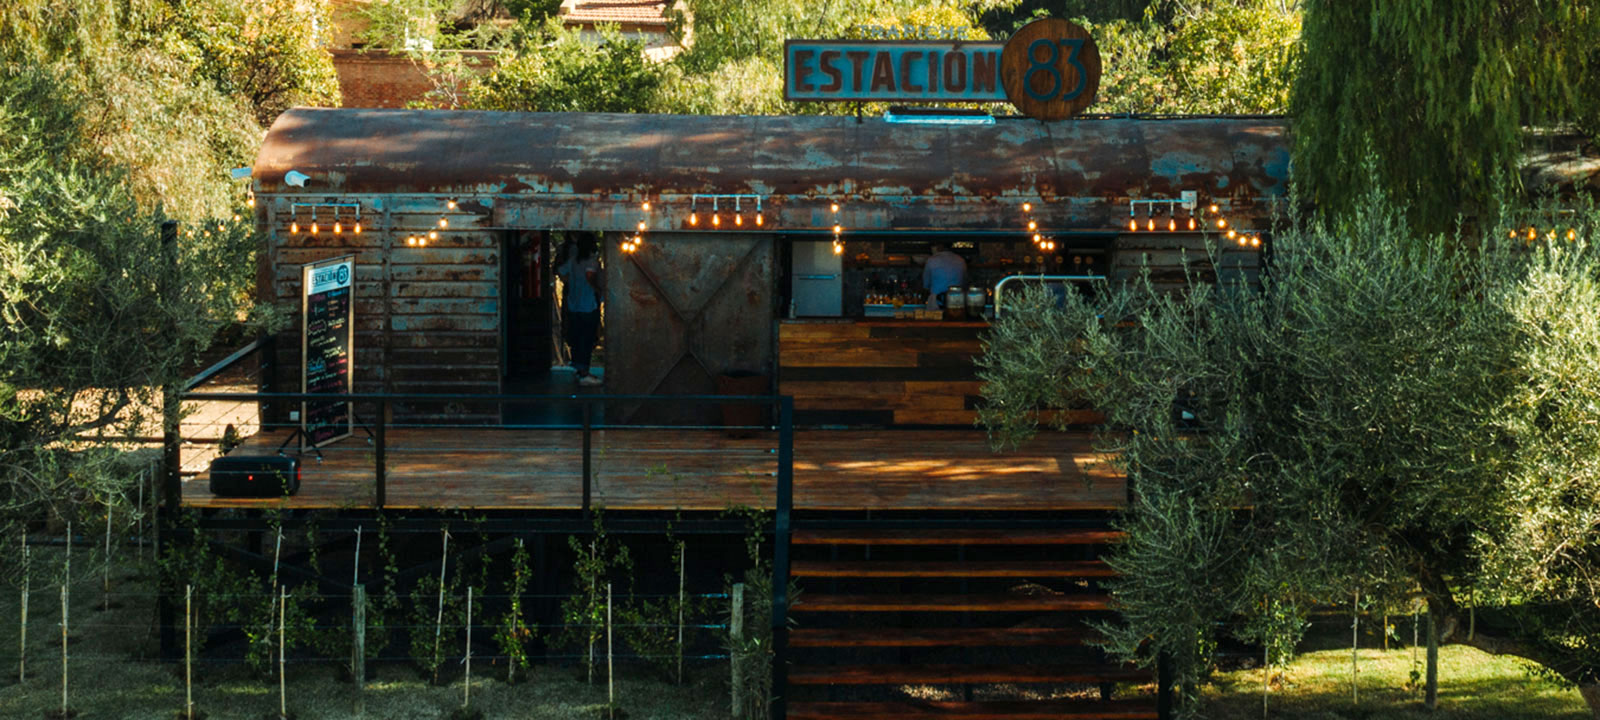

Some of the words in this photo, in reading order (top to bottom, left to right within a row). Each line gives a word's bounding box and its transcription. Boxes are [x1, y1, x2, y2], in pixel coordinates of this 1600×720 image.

[857, 24, 969, 39] TRAPICHE
[794, 44, 997, 93] ESTACIÓN
[1023, 38, 1087, 100] 83
